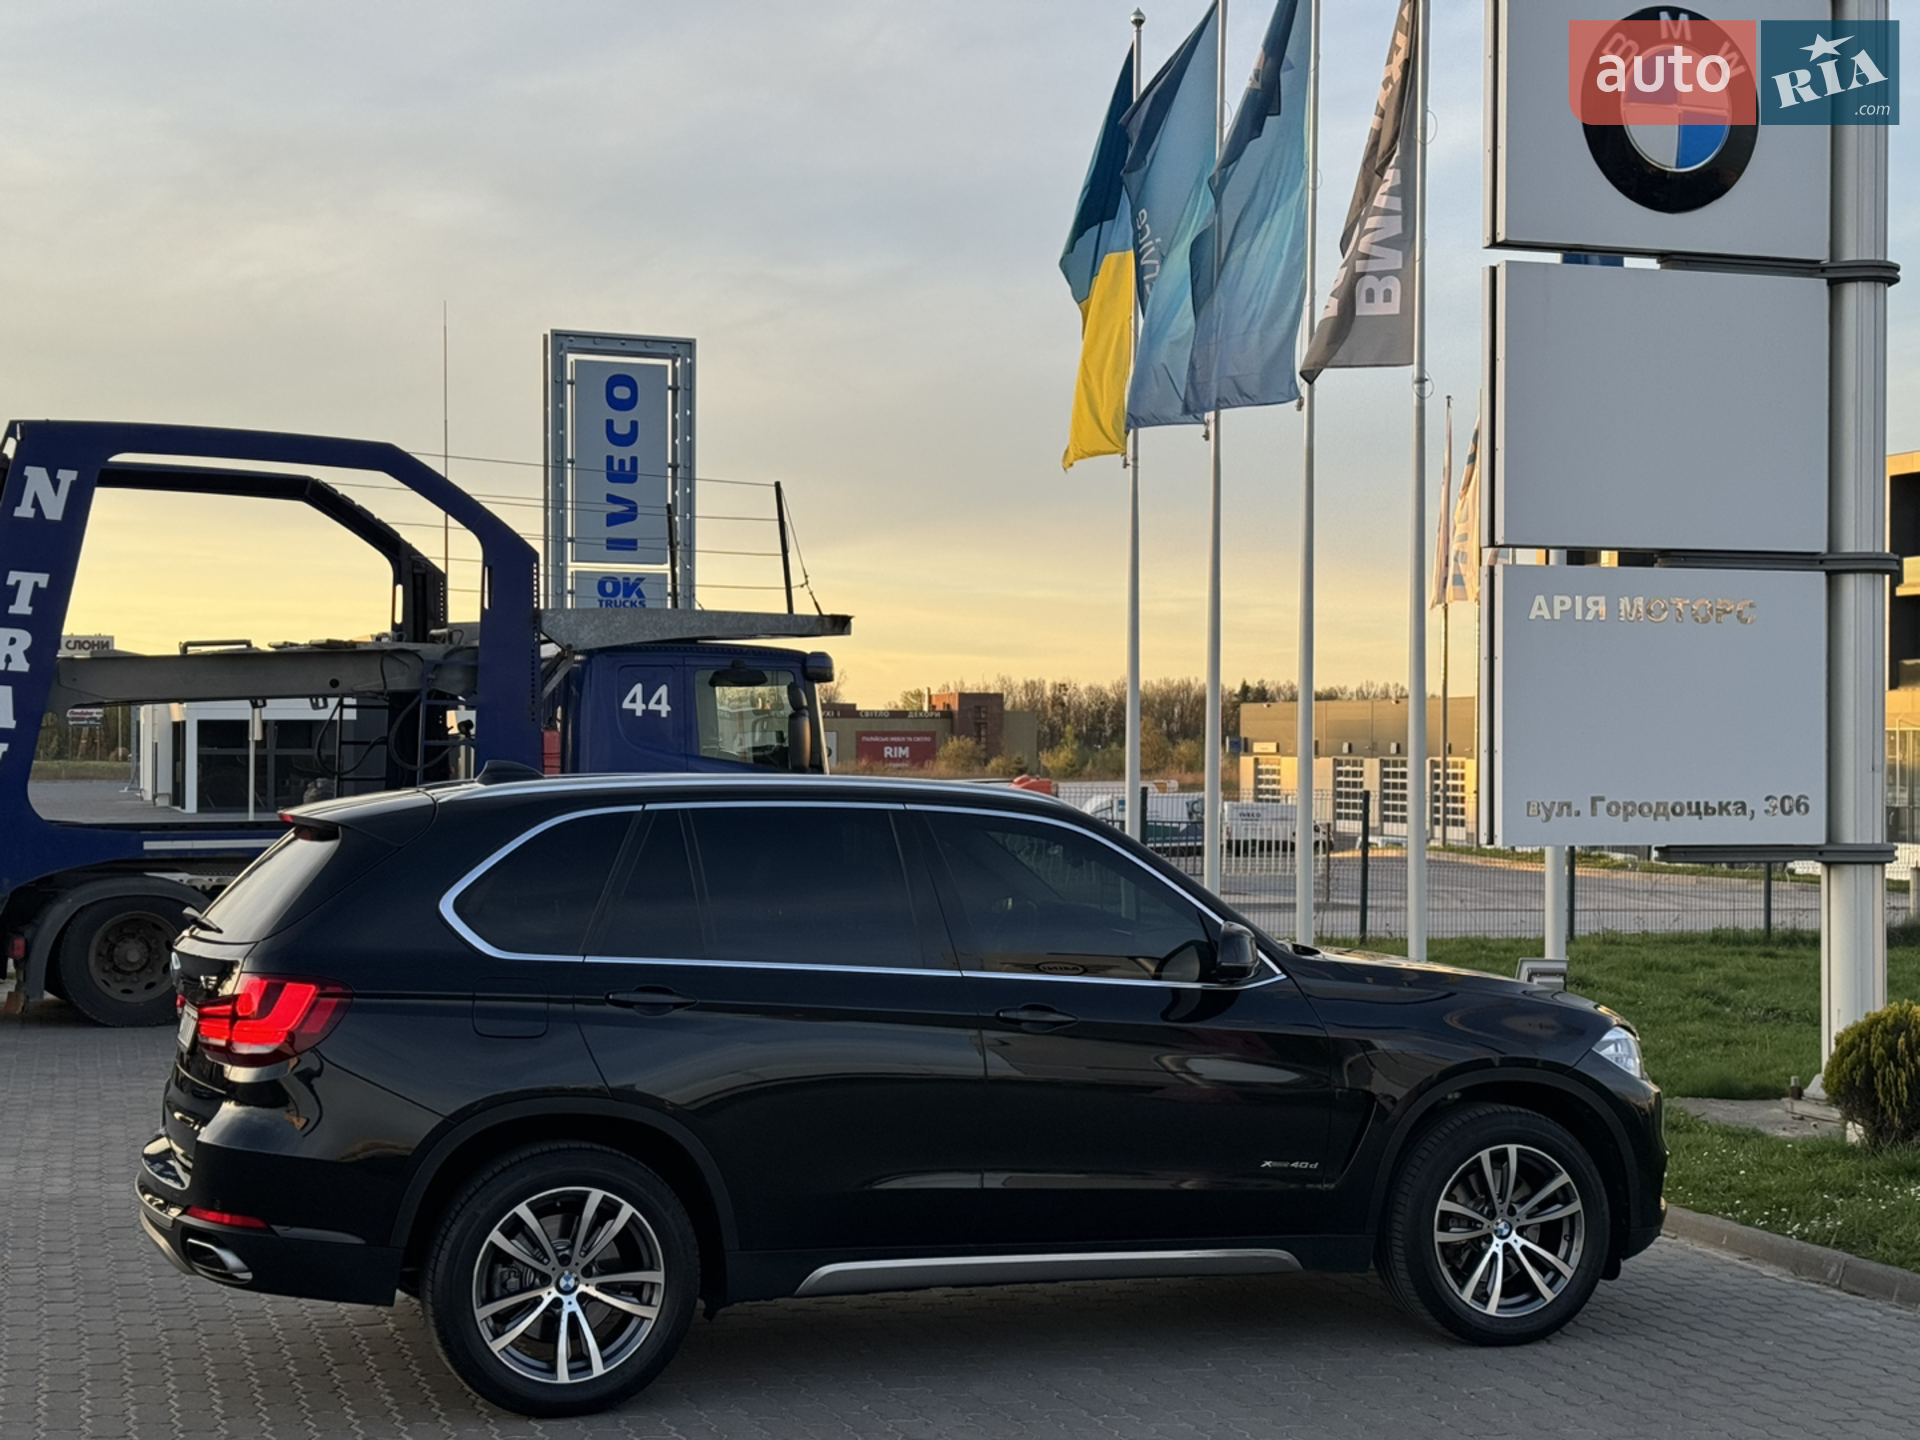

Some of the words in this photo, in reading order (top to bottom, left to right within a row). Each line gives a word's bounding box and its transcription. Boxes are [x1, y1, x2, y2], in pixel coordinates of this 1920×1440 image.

[605, 373, 639, 551] IVECO
[597, 576, 646, 599] OK
[598, 599, 647, 609] TRUCKS
[1528, 594, 1606, 621] АРІЯ
[1618, 596, 1758, 625] МОТОРС
[621, 682, 672, 718] 44
[883, 746, 910, 759] RIM
[1526, 801, 1581, 822] вул.
[1590, 796, 1756, 821] Городоцька,
[1764, 795, 1811, 816] 306
